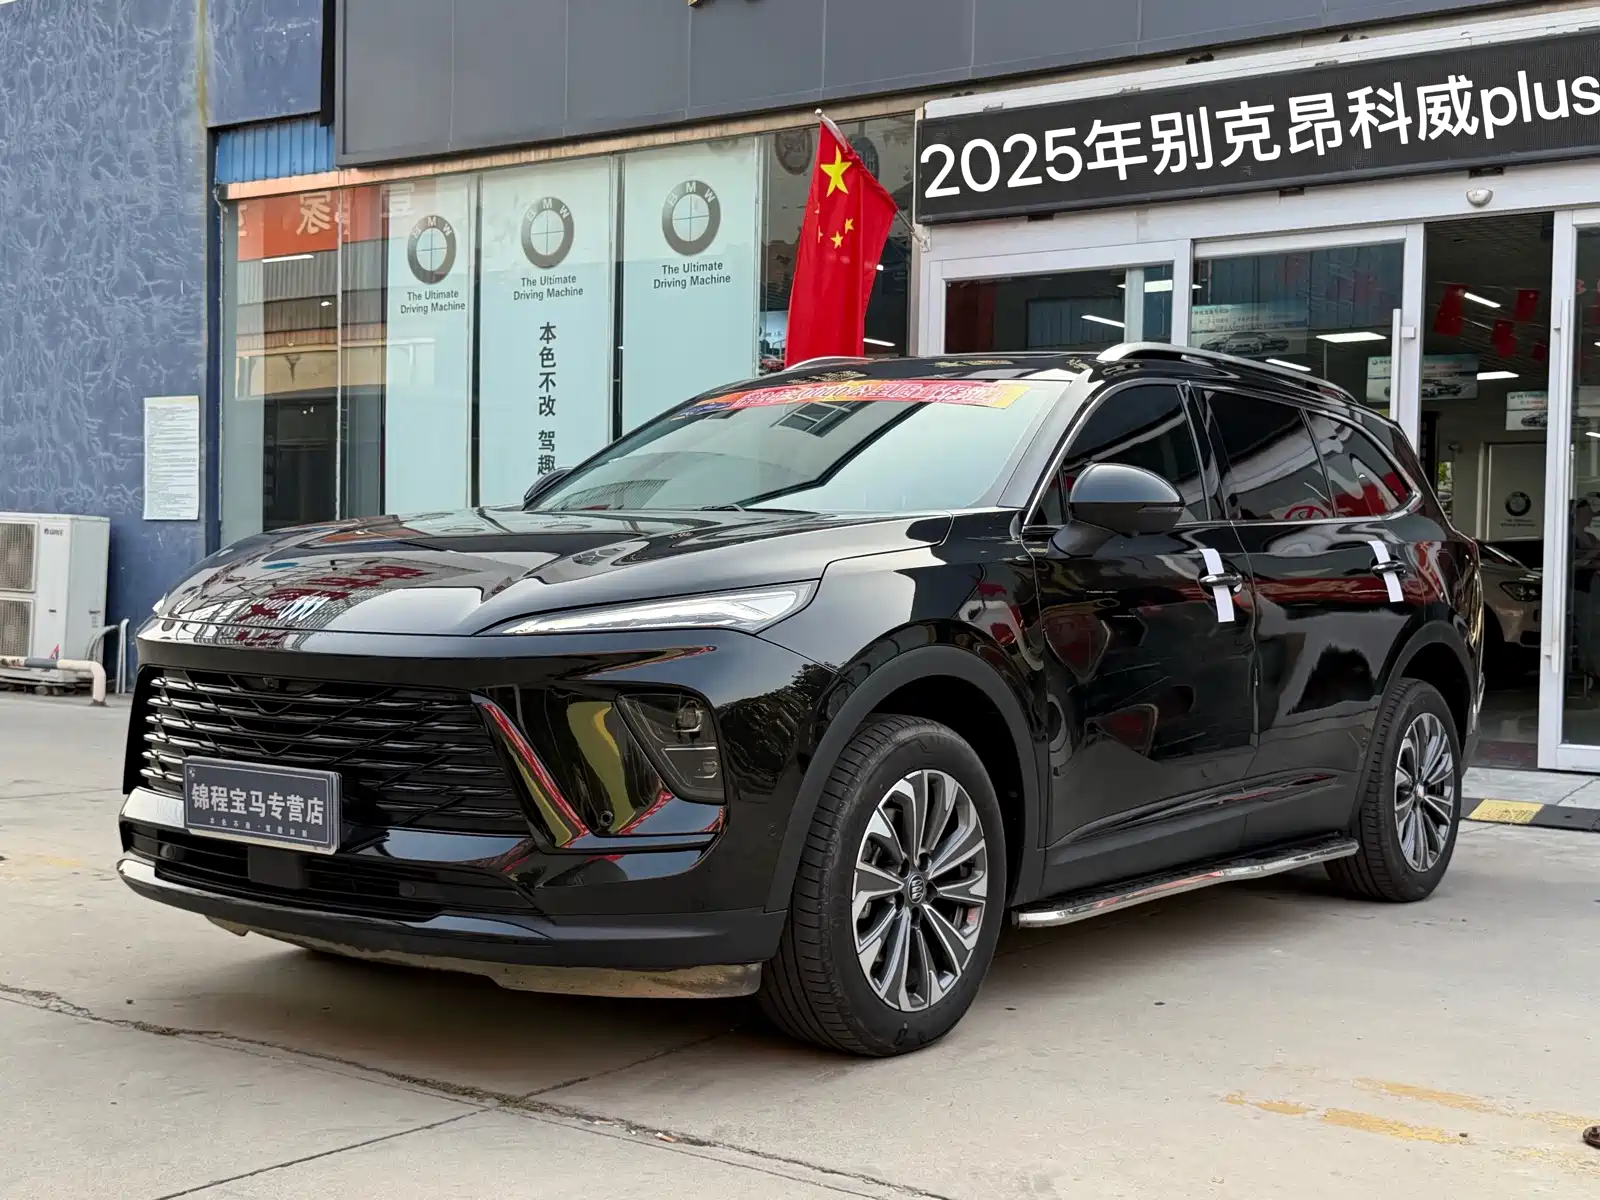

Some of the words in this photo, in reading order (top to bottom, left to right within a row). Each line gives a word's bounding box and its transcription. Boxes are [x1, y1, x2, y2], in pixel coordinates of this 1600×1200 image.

[920, 69, 1600, 199] 2025年别克昂科威plus
[668, 181, 717, 207] BMW
[526, 198, 570, 223] BMW
[411, 215, 453, 239] BMW
[661, 264, 680, 275] The
[682, 261, 723, 274] Ultimate
[520, 277, 537, 287] The
[539, 274, 577, 286] Ultimate
[653, 277, 687, 290] Driving
[690, 273, 731, 287] Machine
[406, 291, 422, 301] The
[424, 289, 459, 300] Ultimate
[513, 289, 544, 301] Driving
[546, 286, 584, 299] Machine
[400, 303, 429, 315] Driving
[430, 301, 466, 312] Machine
[538, 321, 557, 418] 本色不改
[537, 430, 556, 476] 驾趣
[191, 783, 324, 825] 锦程宝马专营店
